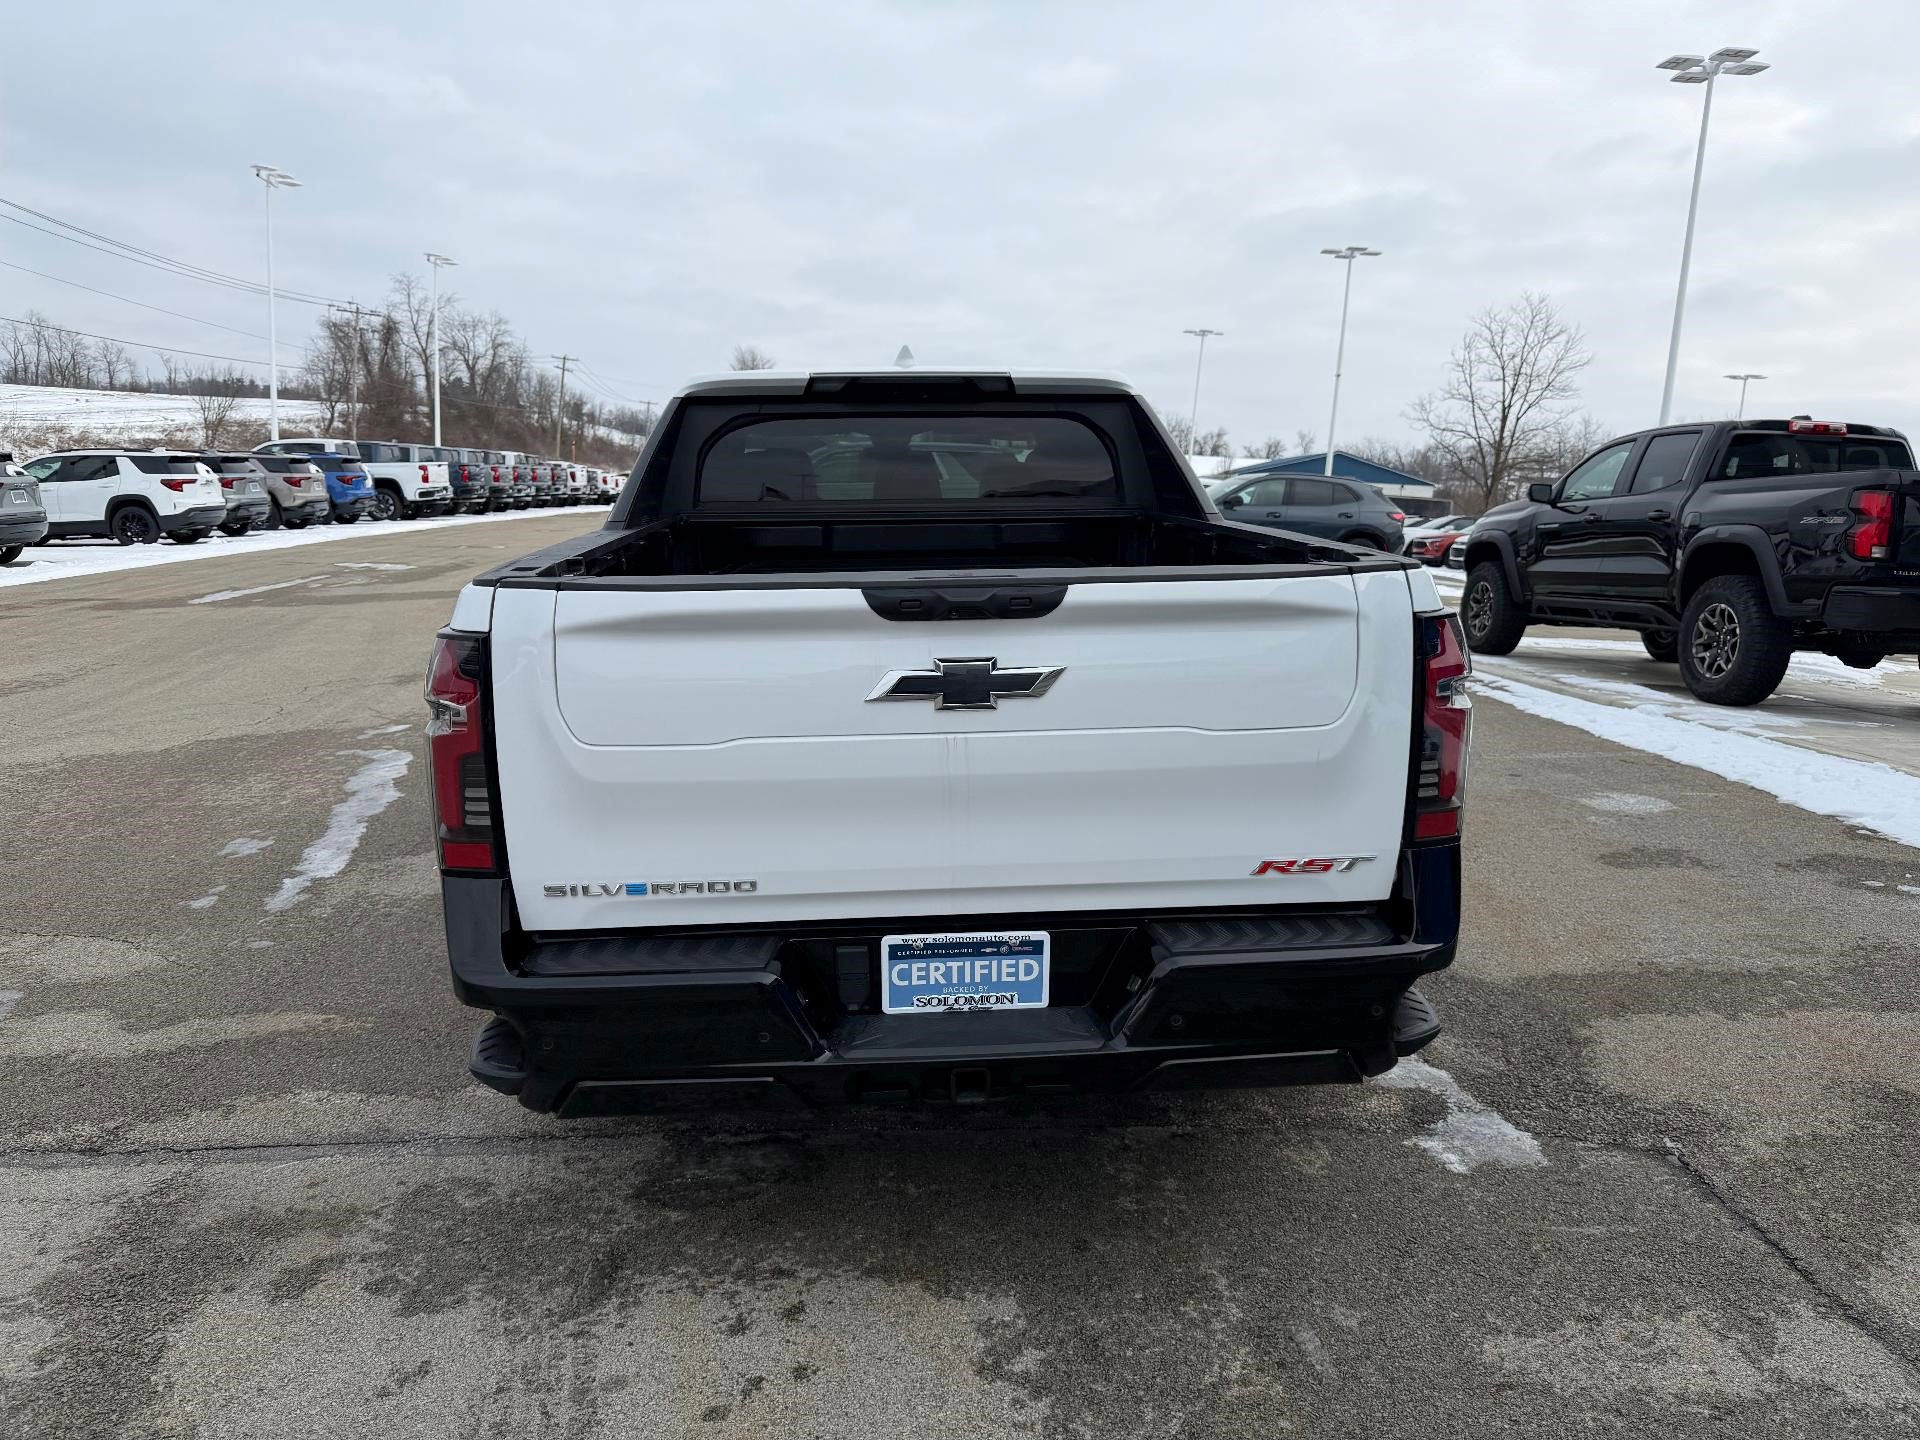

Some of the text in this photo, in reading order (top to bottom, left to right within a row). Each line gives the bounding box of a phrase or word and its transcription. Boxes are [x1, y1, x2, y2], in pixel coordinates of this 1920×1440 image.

[1249, 853, 1377, 875] RST
[543, 879, 757, 898] SILVERADO
[901, 934, 1032, 944] www.solomonauto.com
[891, 959, 1040, 986] CERTIFIED
[943, 986, 976, 994] BACKED
[915, 993, 1016, 1008] SOLOMON
